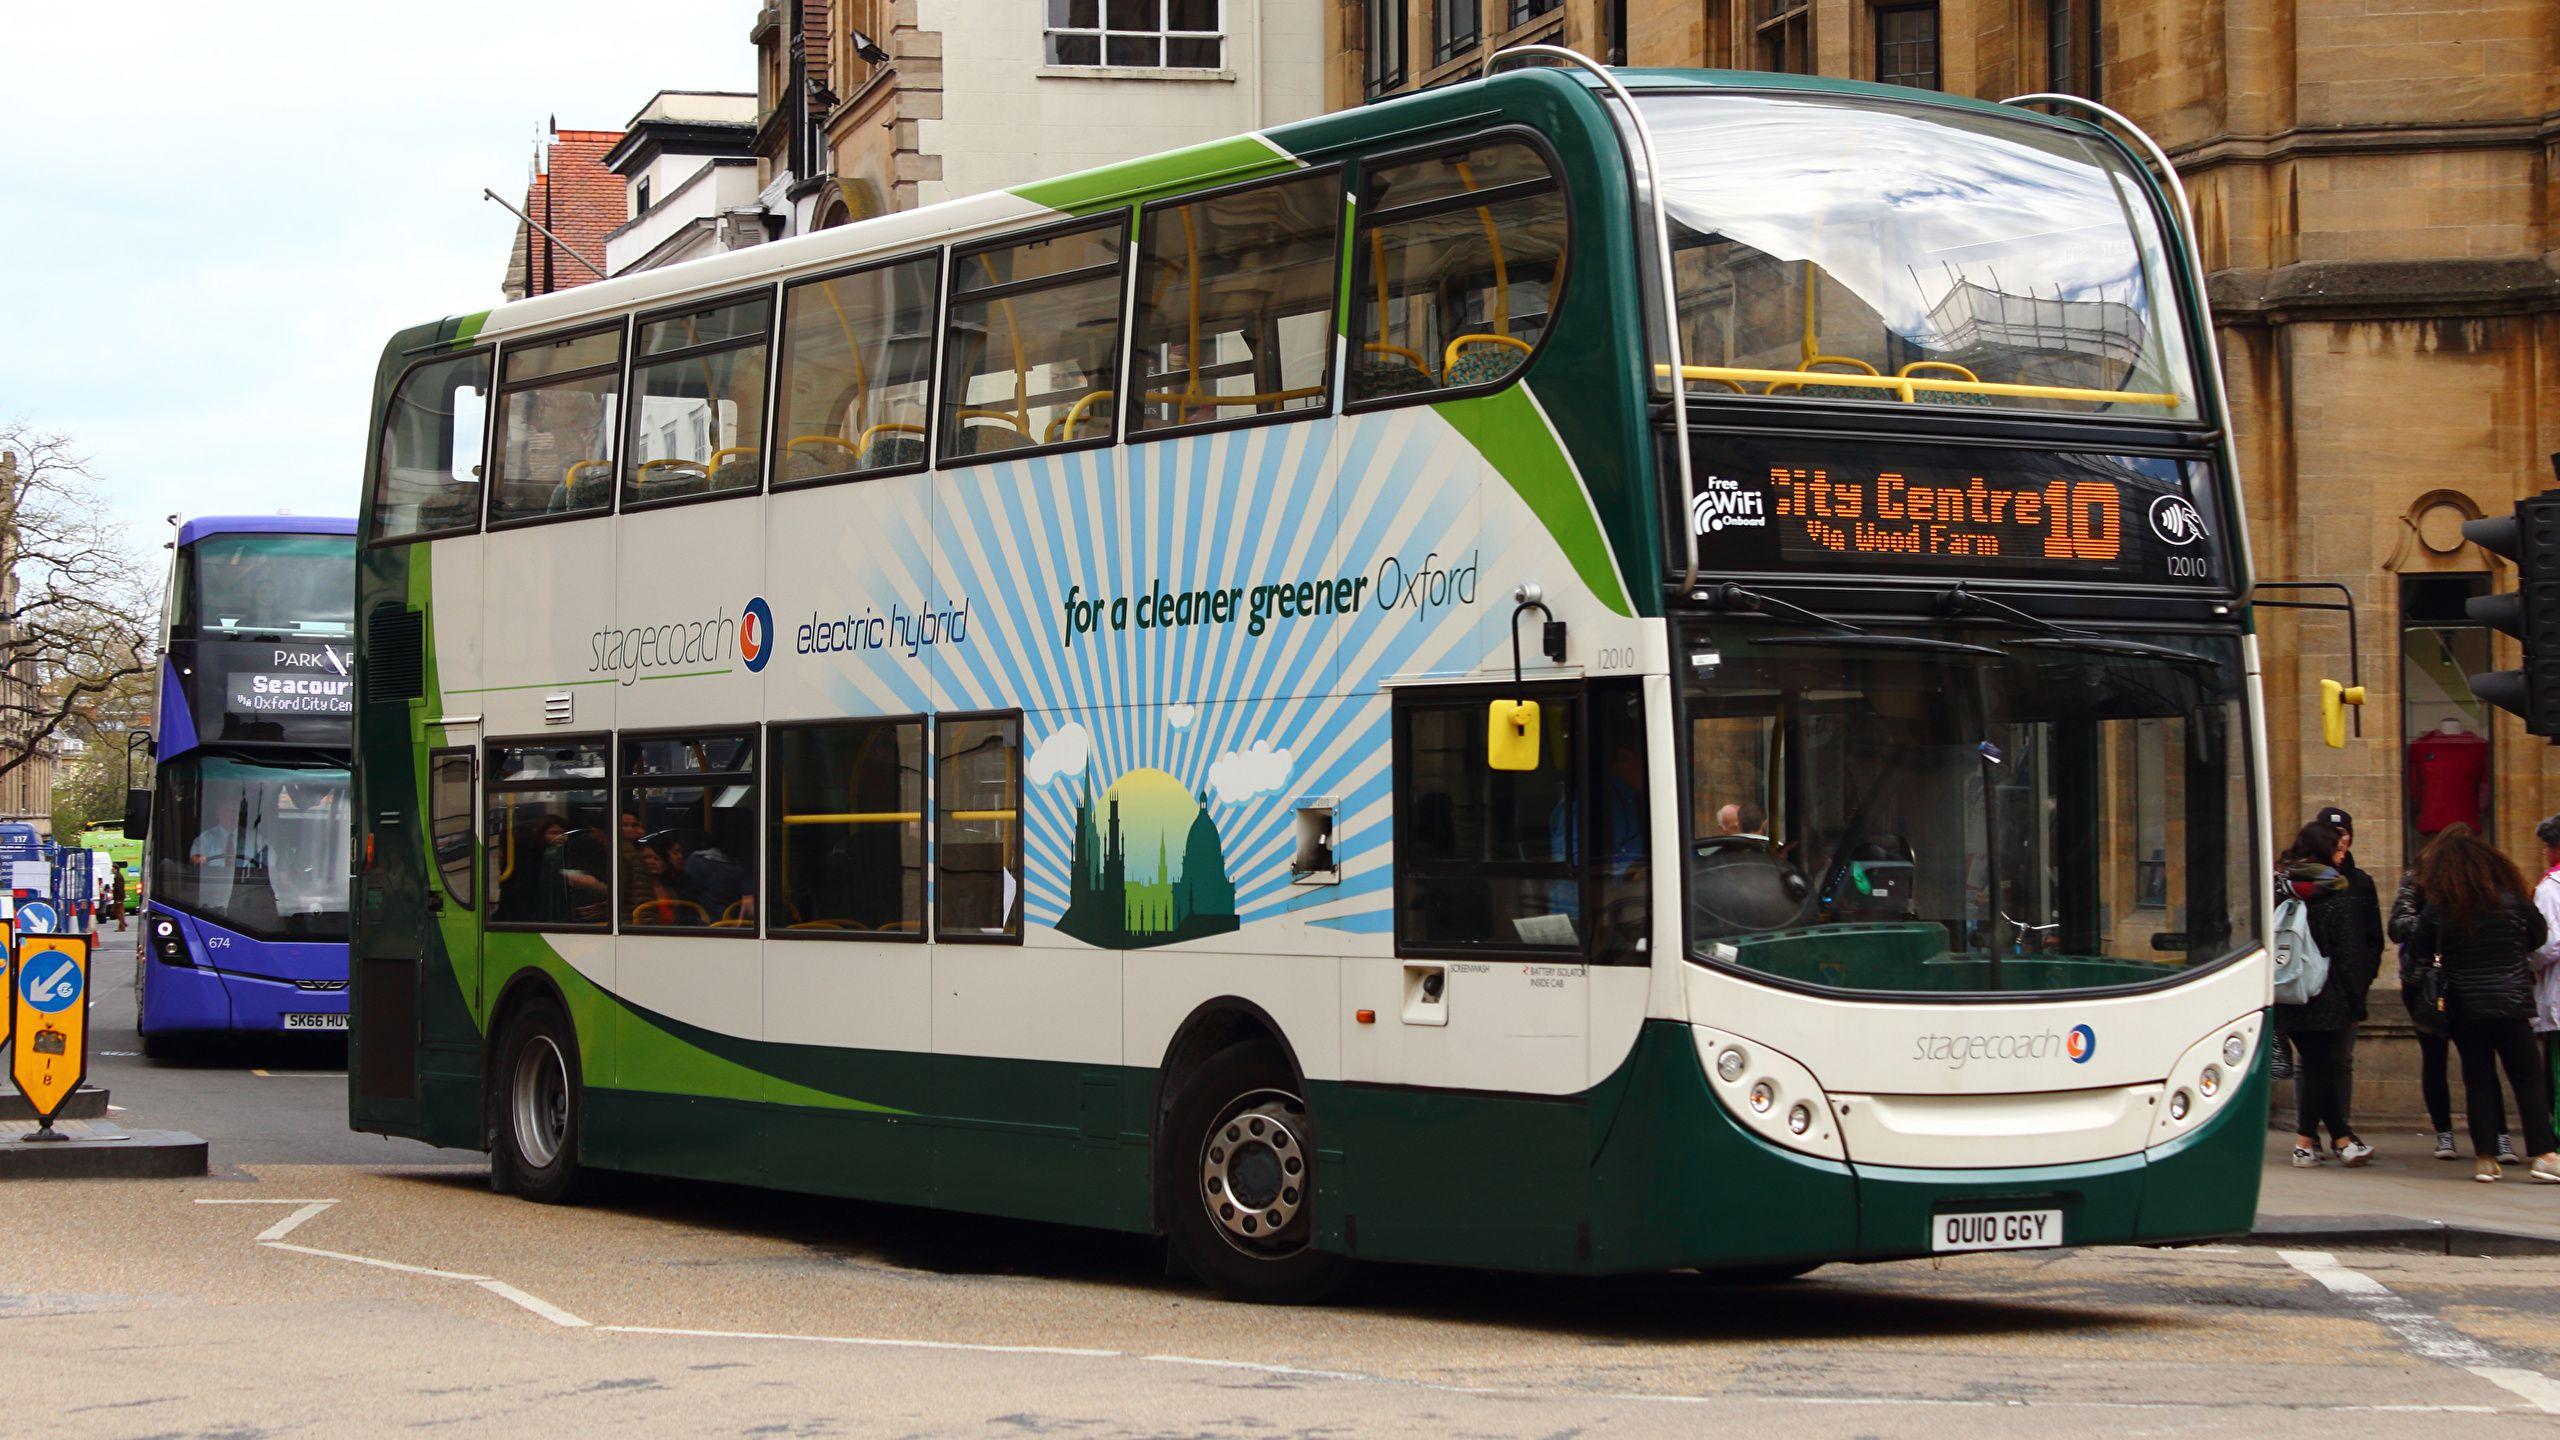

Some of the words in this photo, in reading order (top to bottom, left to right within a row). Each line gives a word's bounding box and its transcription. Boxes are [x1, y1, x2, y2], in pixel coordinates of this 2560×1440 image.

[1708, 475, 1739, 490] Free
[1709, 491, 1763, 514] WiFi
[1877, 473, 2042, 525] Centre
[1722, 516, 1765, 526] Onboard
[2043, 480, 2120, 560] 10
[1855, 522, 1920, 553] Wood
[1929, 525, 1999, 556] Farm
[2167, 556, 2206, 577] 12010
[1064, 585, 1105, 647] for
[1111, 597, 1127, 631] a
[1135, 579, 1242, 629] cleaner
[1247, 573, 1368, 636] greener
[1376, 550, 1478, 622] Oxford
[797, 607, 884, 655] electric
[889, 597, 969, 658] hybrid
[589, 606, 734, 686] stagecoach
[274, 651, 323, 668] PARK
[1598, 648, 1634, 669] 12010
[253, 675, 353, 695] Seacour
[254, 695, 300, 710] Oxford
[301, 696, 327, 712] City
[13, 835, 28, 843] 117
[209, 937, 231, 949] 674
[290, 1015, 324, 1027] SK66
[1912, 1028, 2061, 1070] stagecoach
[1947, 1216, 1997, 1243] OU10
[2004, 1214, 2047, 1241] GGY
